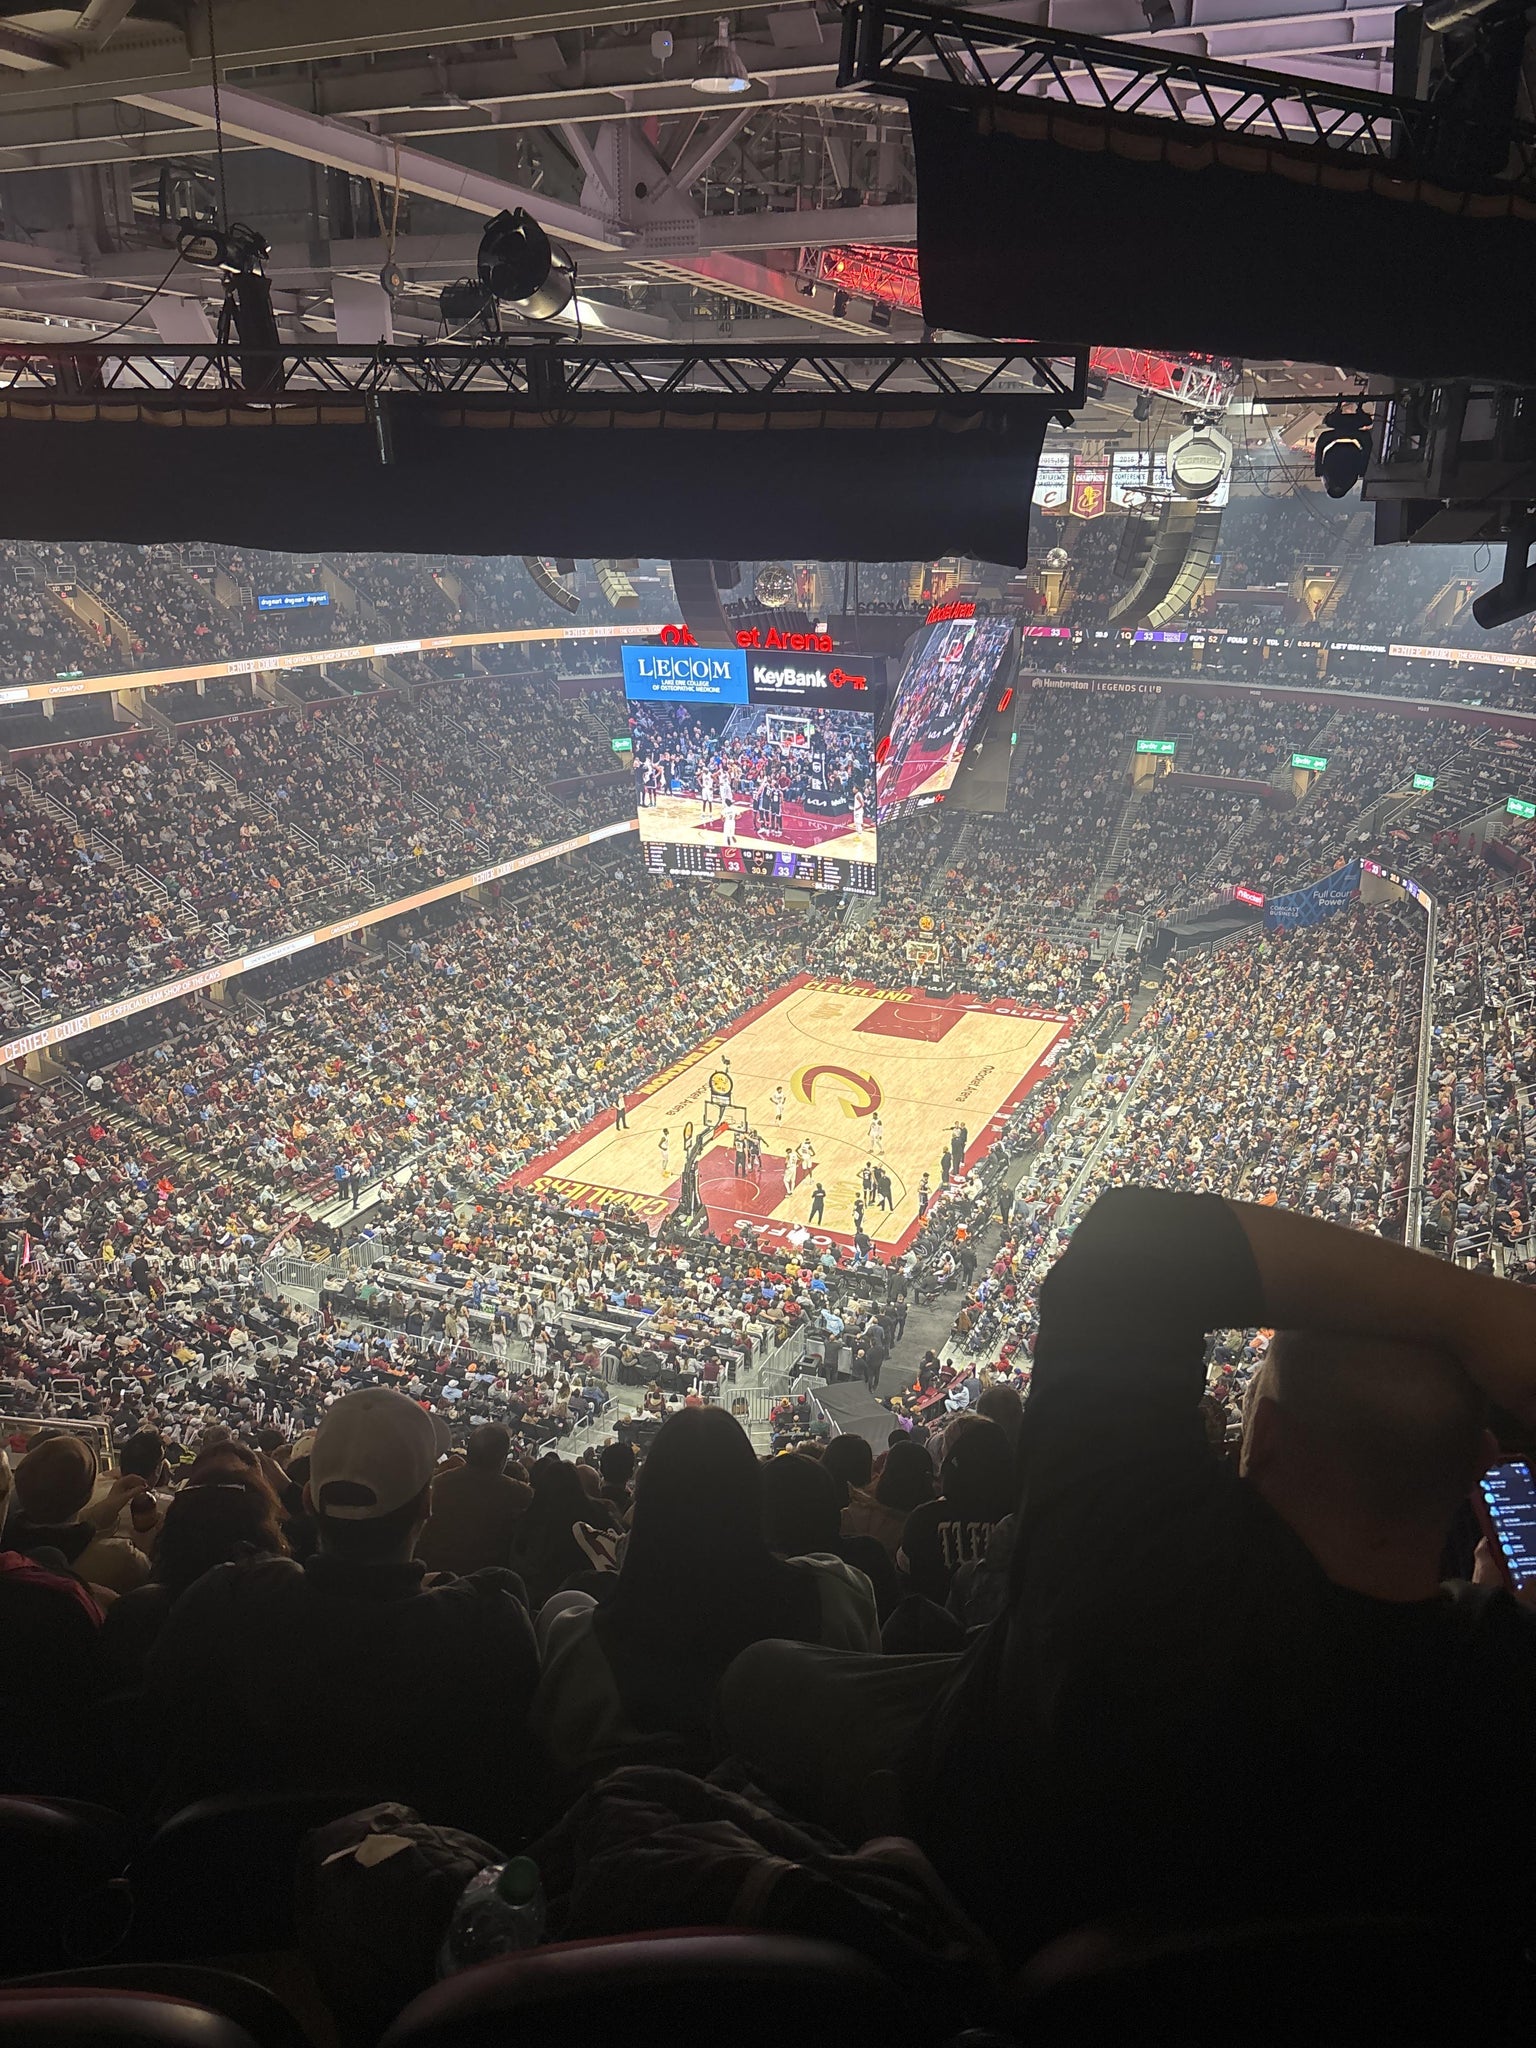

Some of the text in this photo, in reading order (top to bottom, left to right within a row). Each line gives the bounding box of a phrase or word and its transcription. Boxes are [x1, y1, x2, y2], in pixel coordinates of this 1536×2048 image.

[765, 627, 833, 652] Arena
[753, 665, 827, 689] KeyBank
[1097, 683, 1136, 692] LEGENDS
[728, 862, 790, 876] 33 30.9 33
[1312, 890, 1328, 899] Full
[802, 980, 914, 1002] CLEVELAND
[4, 1030, 49, 1061] CENTER
[54, 1015, 93, 1041] COURT
[98, 1010, 114, 1022] THE
[114, 1000, 144, 1016] OFFICIAL
[144, 993, 164, 1006] TEAM
[164, 985, 182, 998] SHOP
[204, 970, 222, 982] CAVS
[995, 1008, 1070, 1022] CLIFFS
